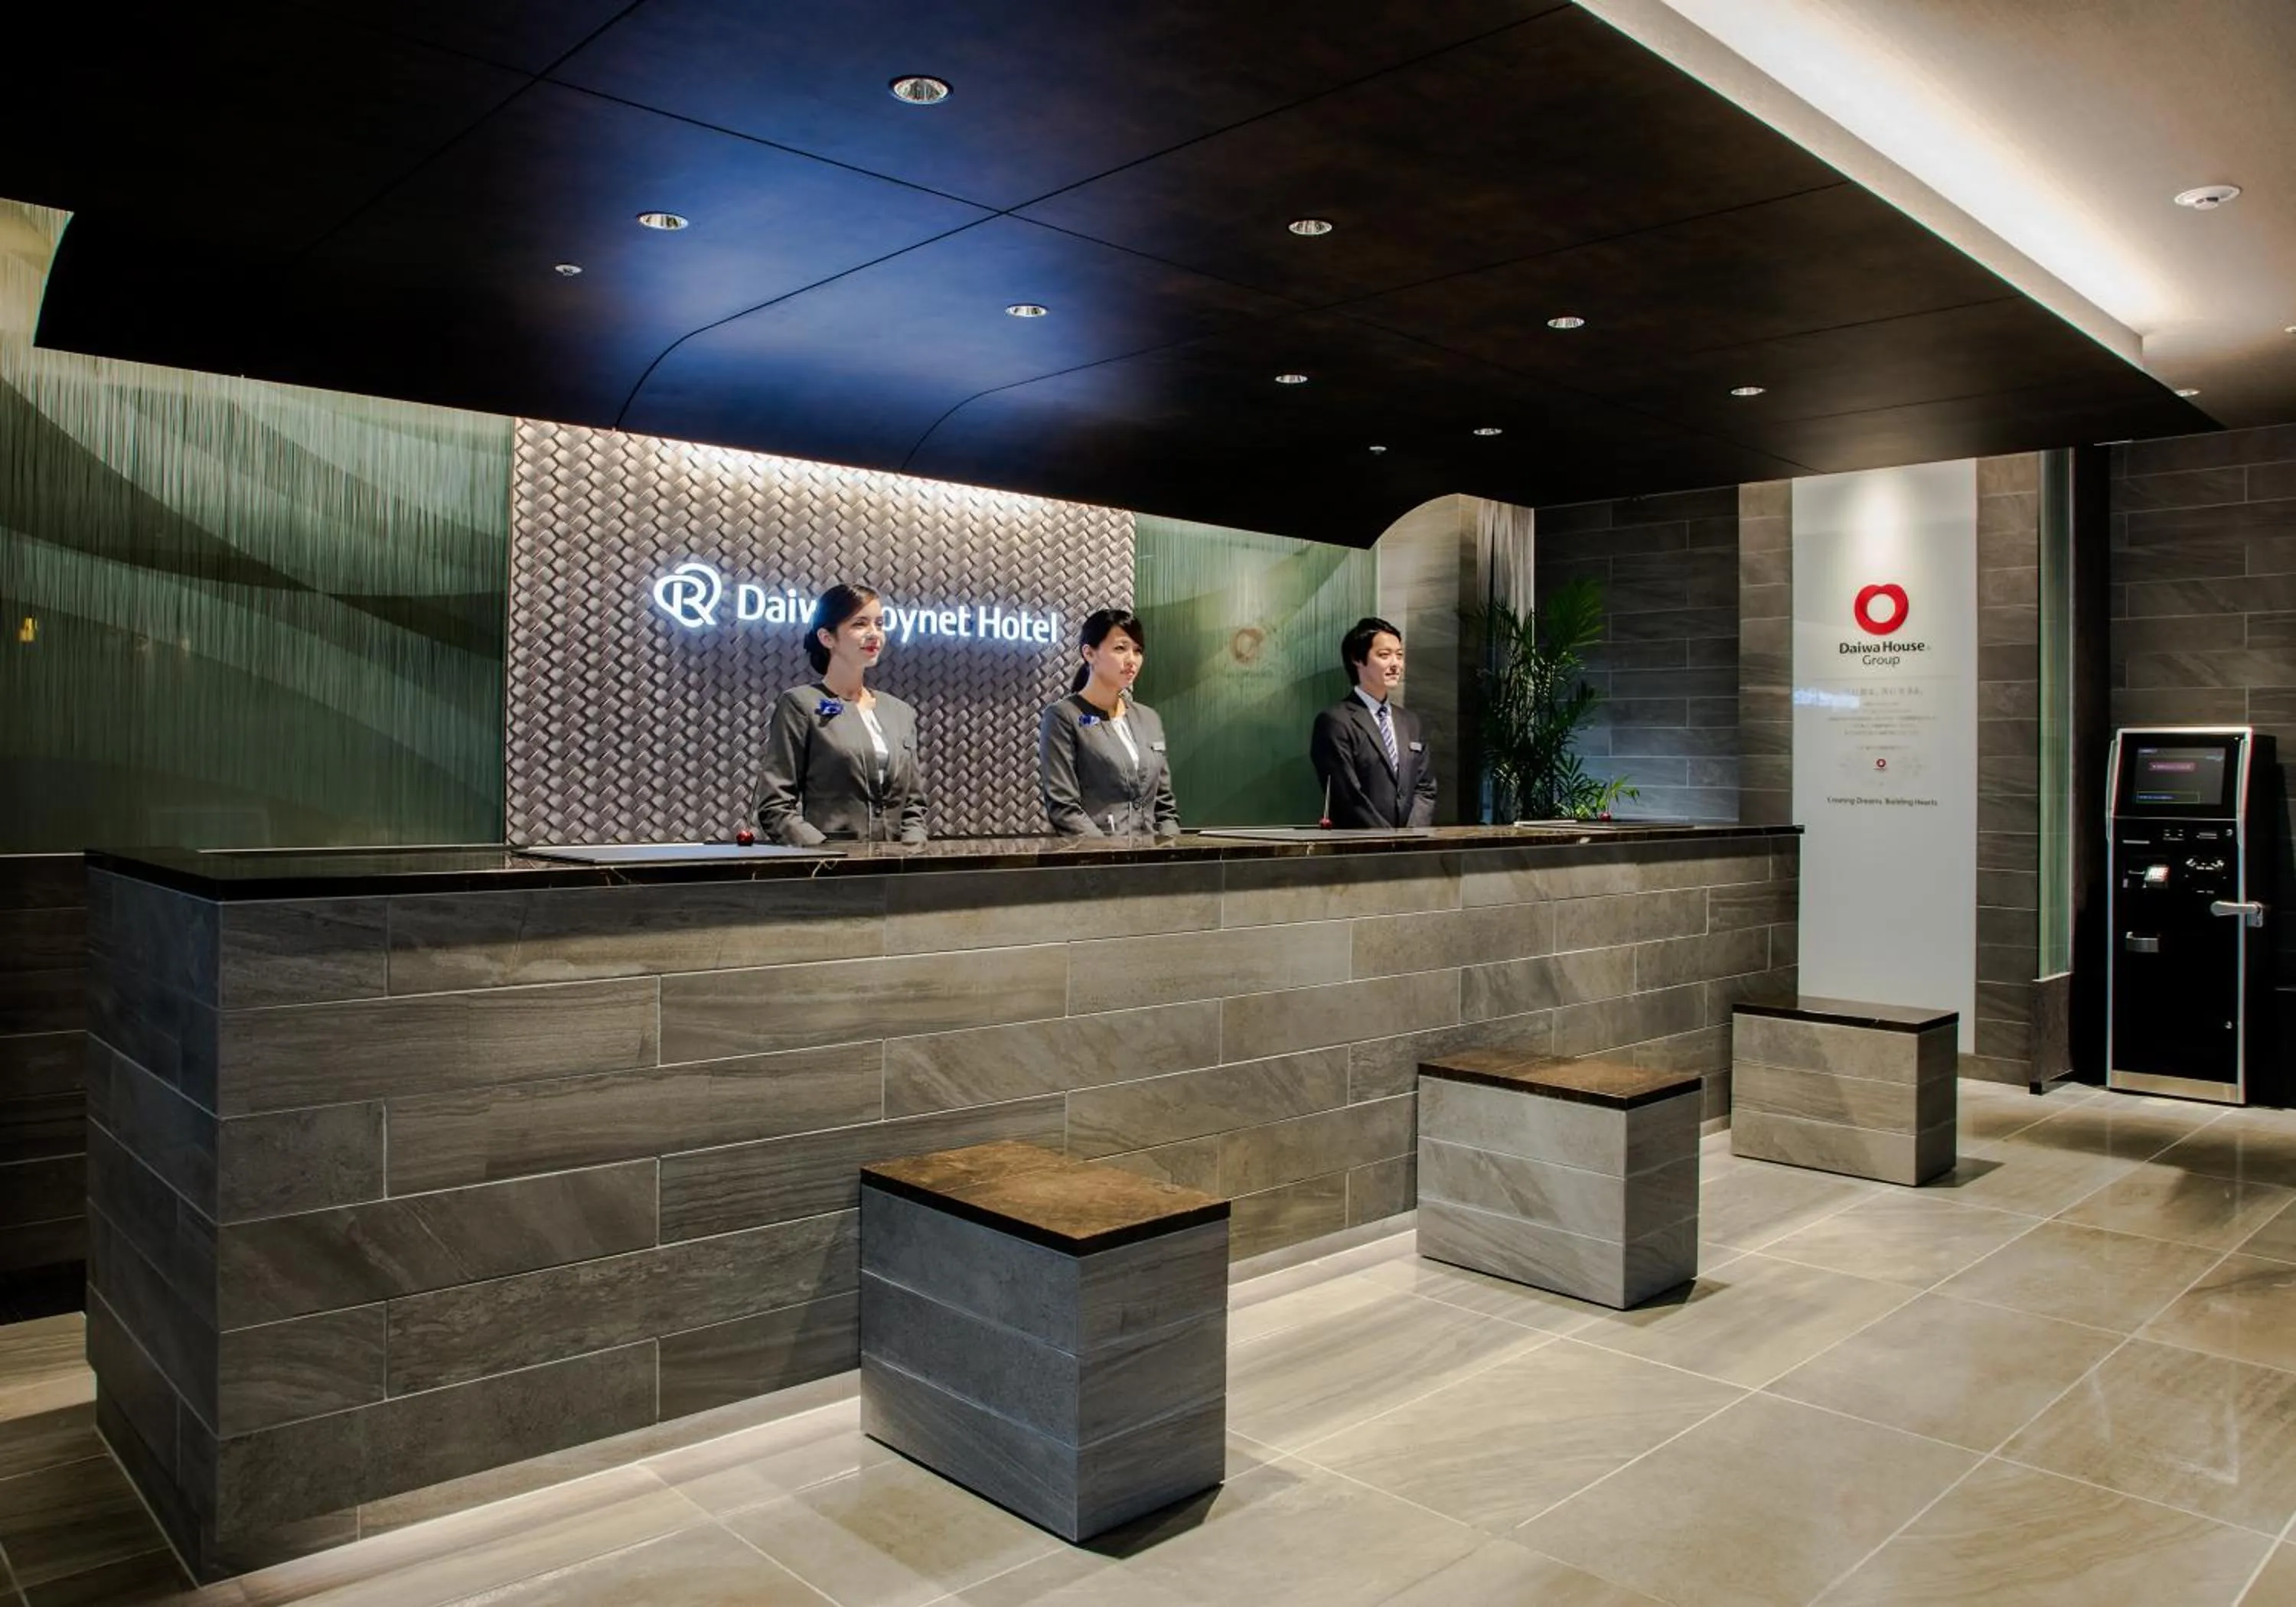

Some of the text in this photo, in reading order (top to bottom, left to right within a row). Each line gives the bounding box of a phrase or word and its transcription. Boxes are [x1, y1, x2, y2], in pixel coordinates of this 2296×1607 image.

[881, 605, 971, 644] oynet
[979, 606, 1057, 644] Hotel
[1839, 641, 1926, 654] Daiwa House
[1862, 654, 1900, 667] Group
